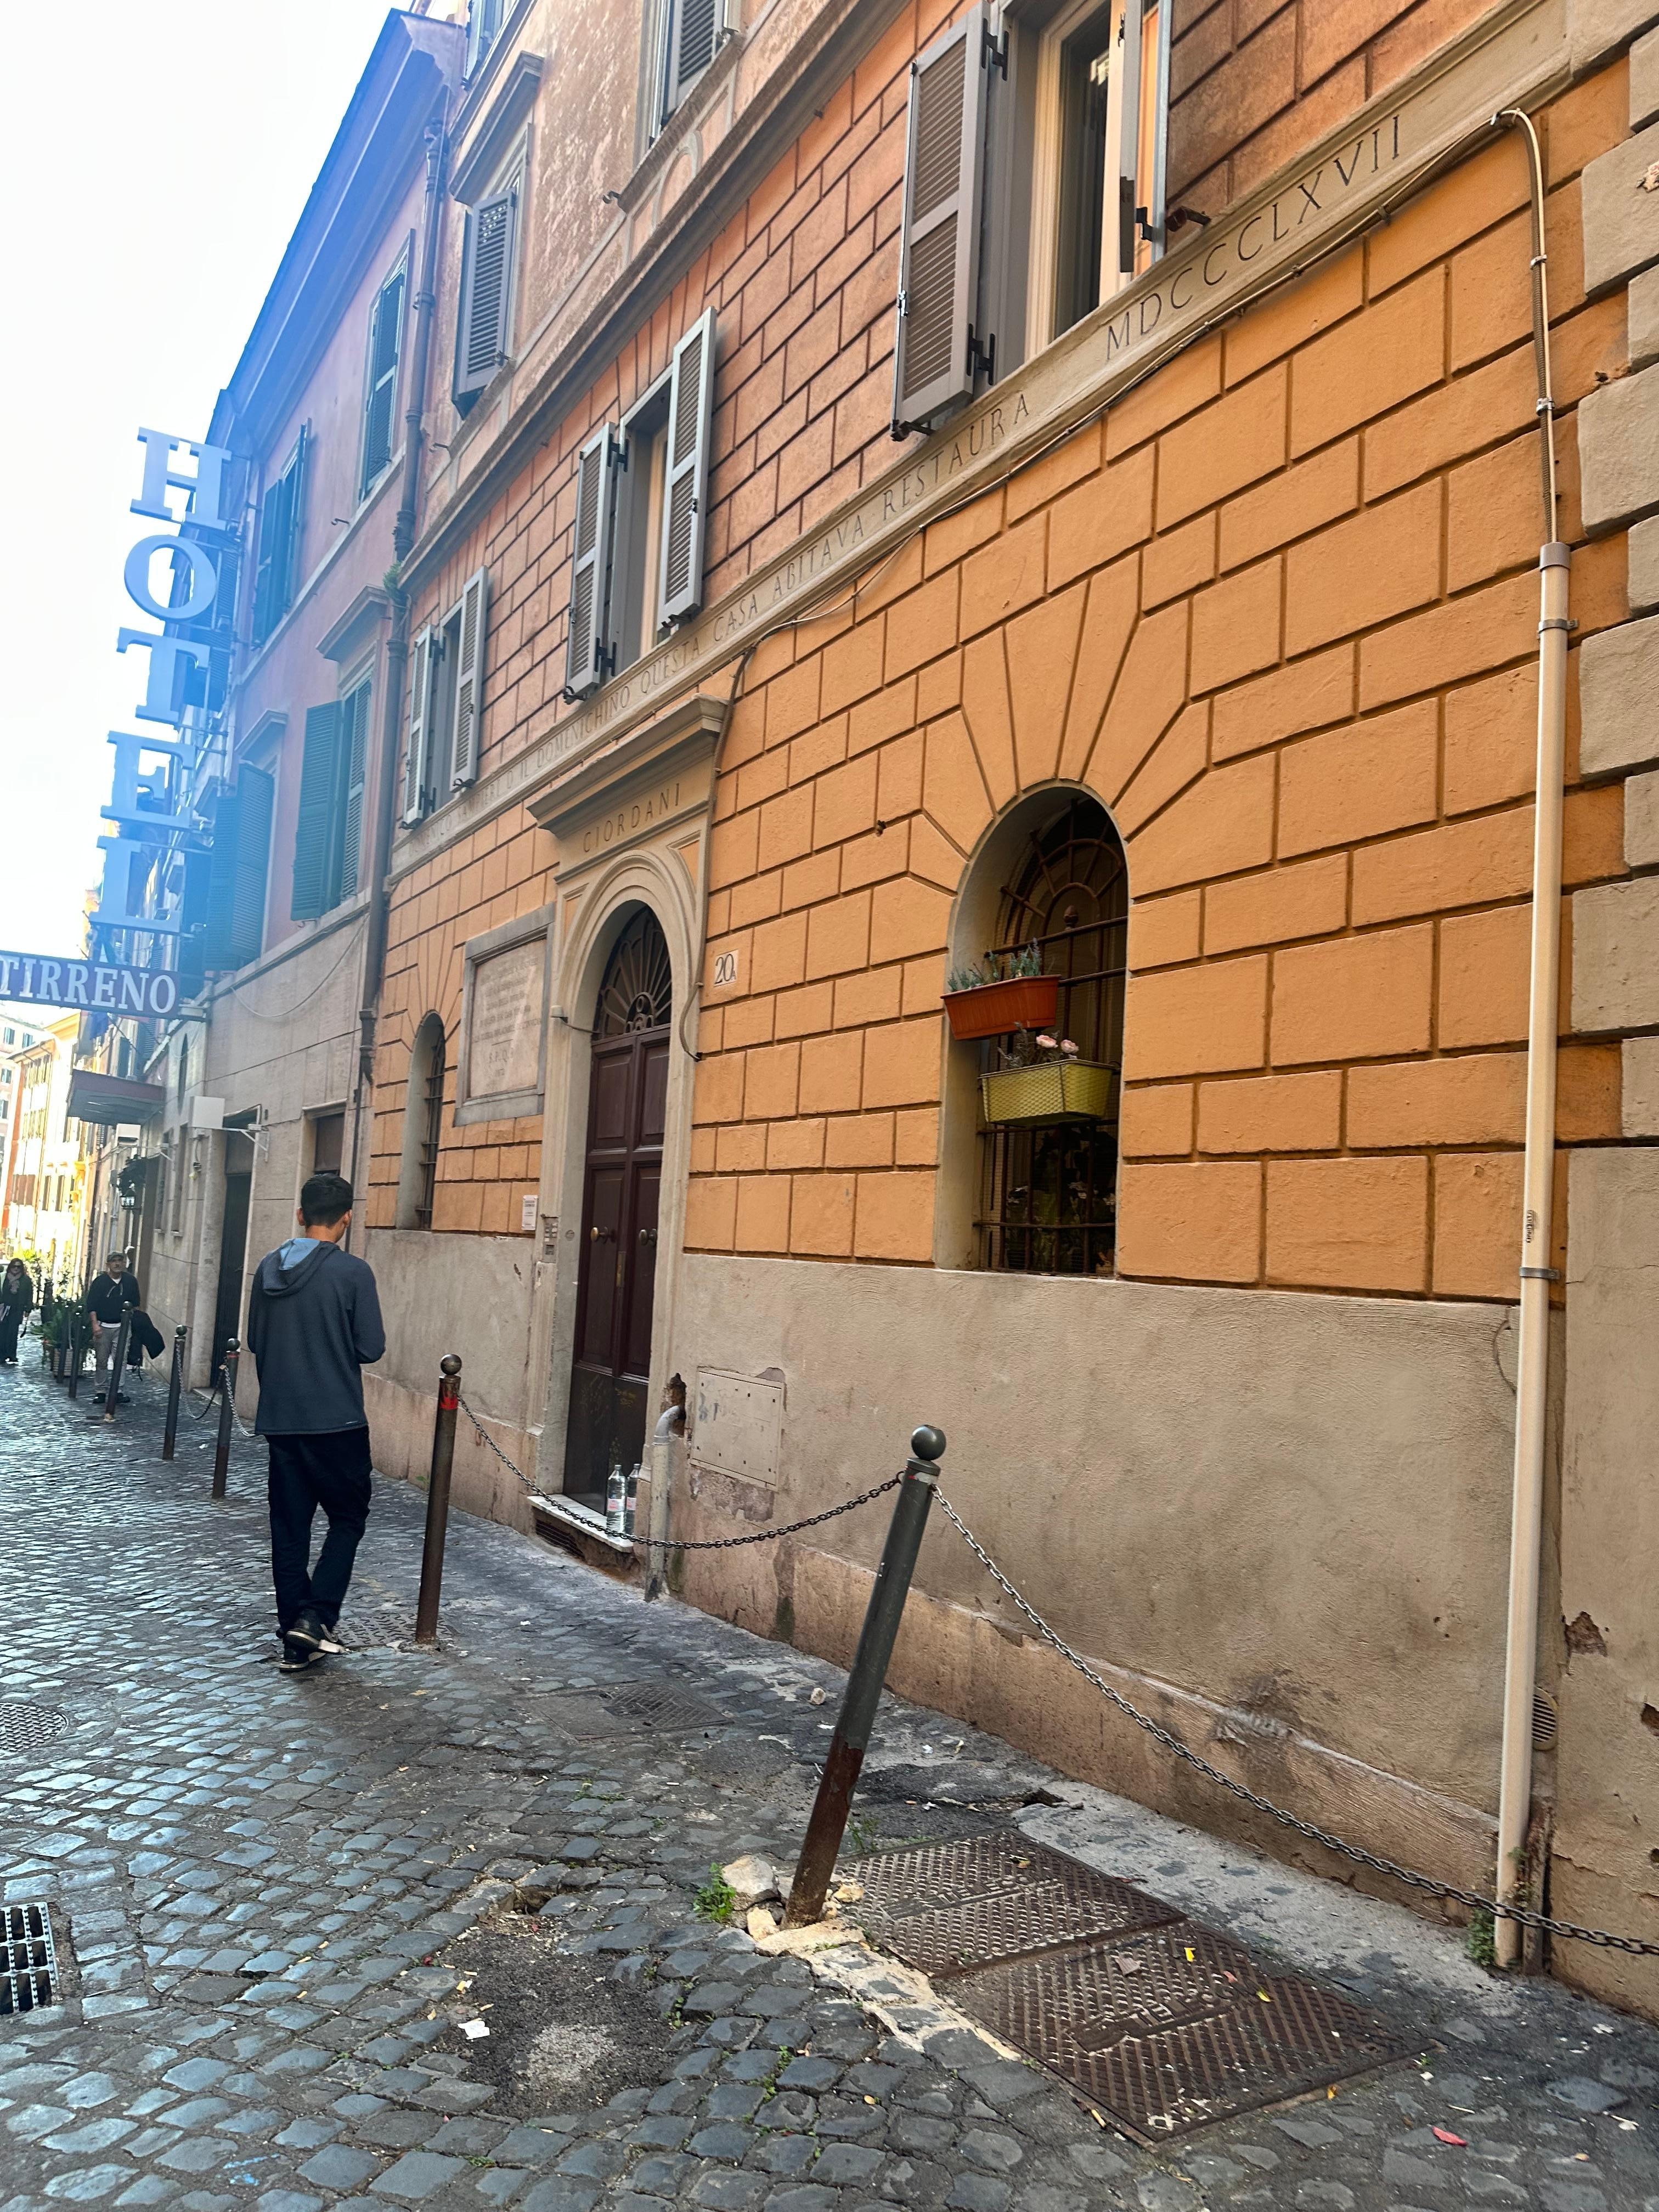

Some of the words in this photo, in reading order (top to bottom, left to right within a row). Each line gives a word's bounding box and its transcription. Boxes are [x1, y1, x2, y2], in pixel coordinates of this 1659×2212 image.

[89, 426, 233, 933] HOTEL
[537, 686, 630, 768] DOMENICHINO
[641, 637, 700, 694] QUESTA
[714, 594, 758, 641] CASA
[772, 515, 864, 600] ABITAVA
[884, 394, 1029, 520] RESTAURA
[1107, 115, 1400, 361] MDCCCLXVII
[0, 955, 176, 1013] TIRRENO
